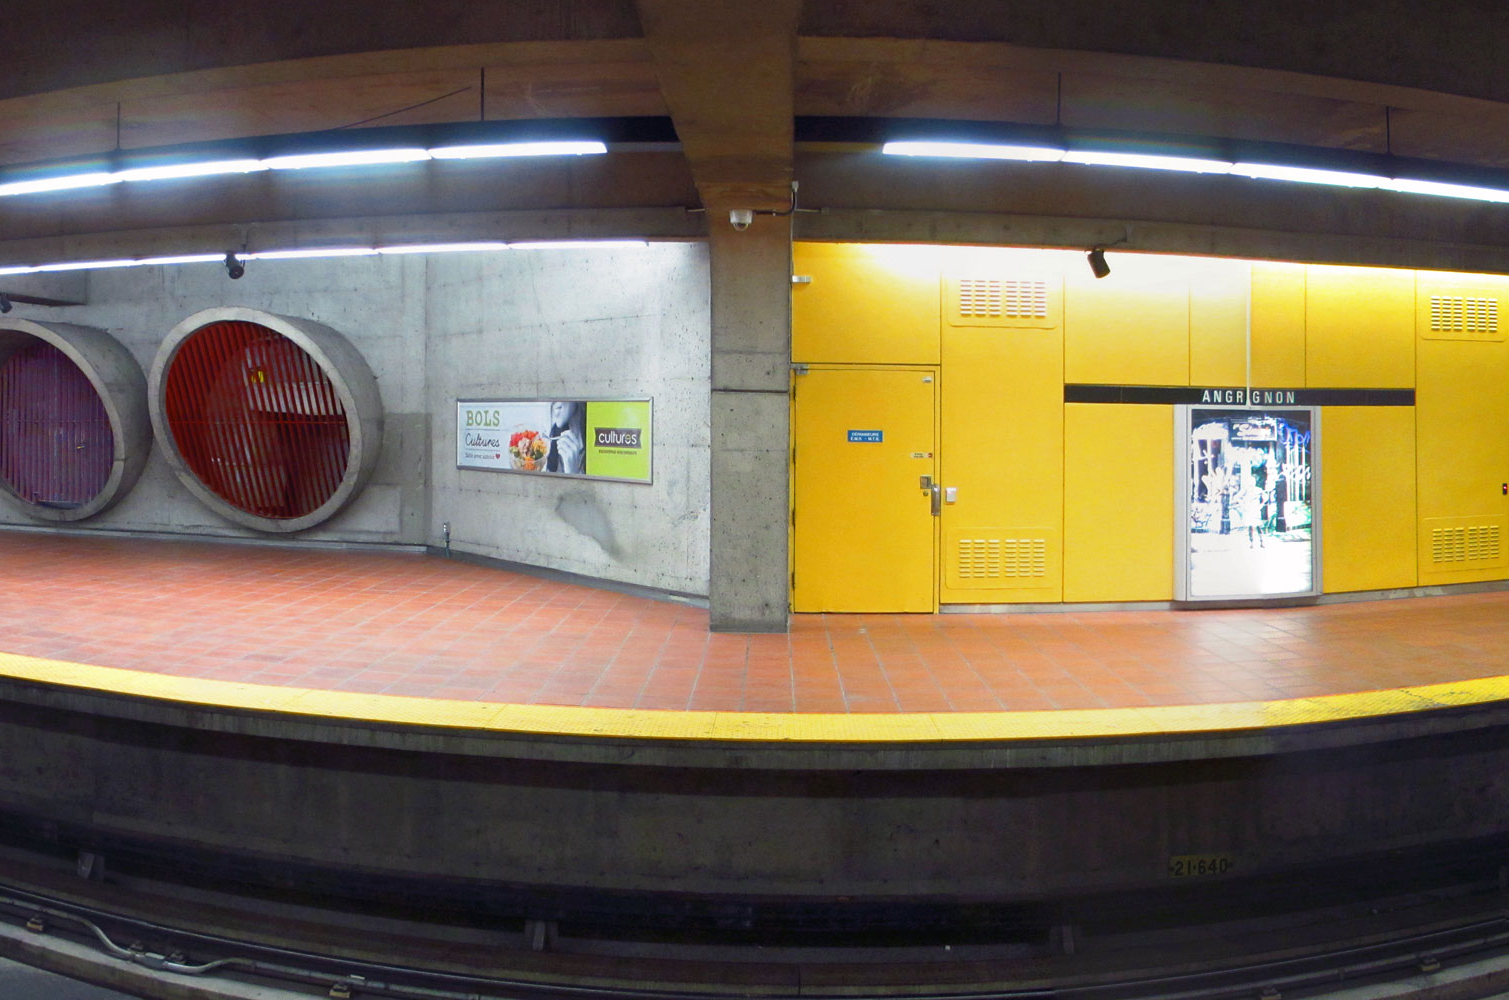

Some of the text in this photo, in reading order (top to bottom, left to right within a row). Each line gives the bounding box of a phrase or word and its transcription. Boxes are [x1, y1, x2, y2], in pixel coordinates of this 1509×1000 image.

[1202, 390, 1295, 404] ANGRGNON
[466, 410, 500, 427] BOLS
[465, 433, 500, 448] Cultures
[598, 431, 637, 445] cultures
